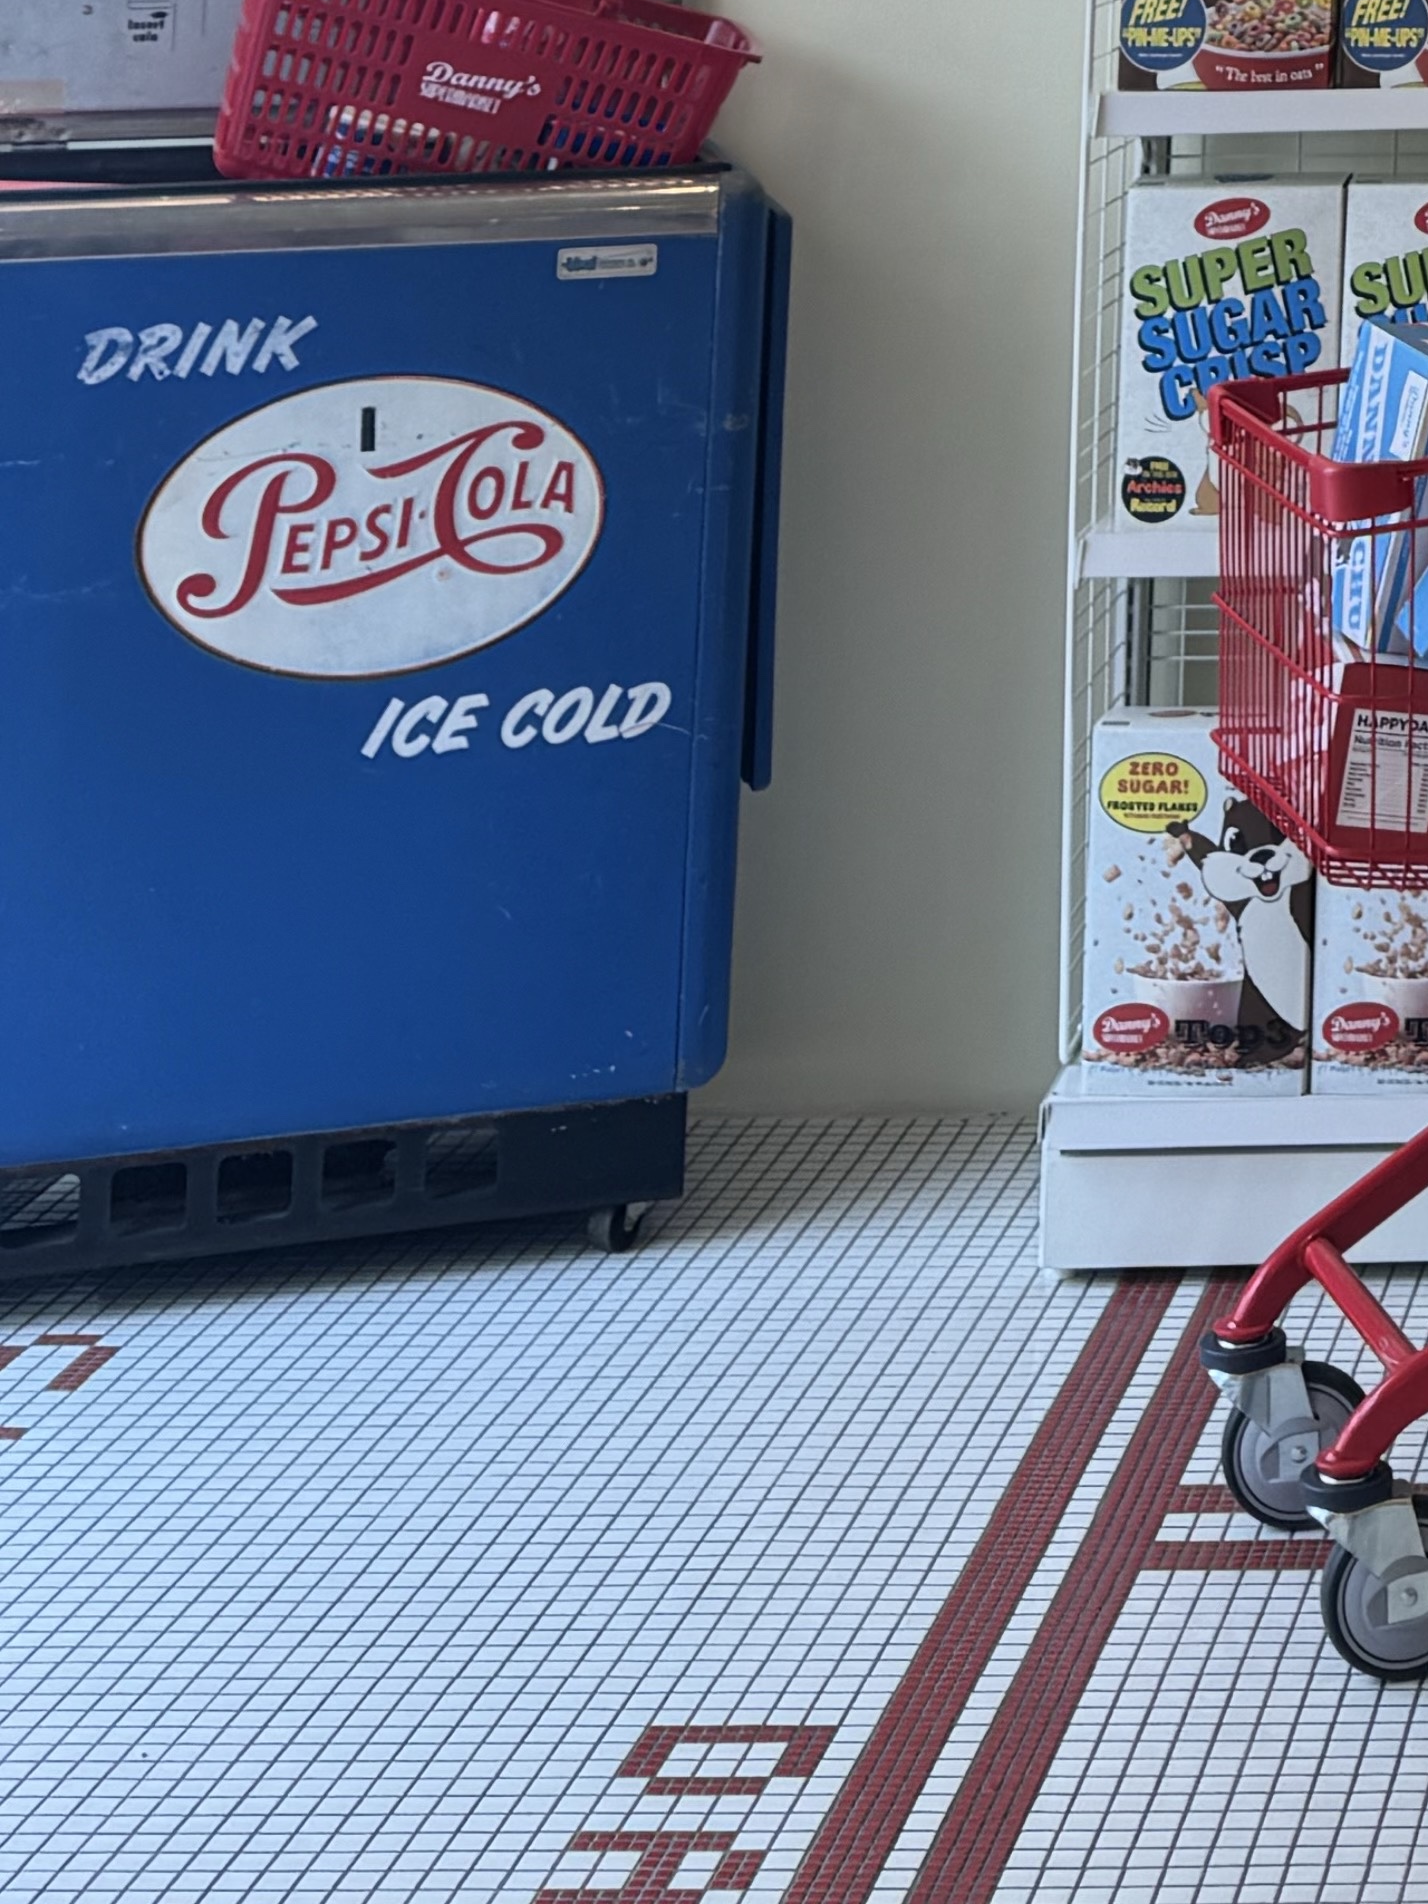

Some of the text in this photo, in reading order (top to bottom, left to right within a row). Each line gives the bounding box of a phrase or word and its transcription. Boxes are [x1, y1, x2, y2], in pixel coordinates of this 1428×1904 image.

[421, 61, 542, 100] Danny's
[1205, 202, 1260, 228] Danny's
[1130, 228, 1314, 321] SUPER
[76, 315, 318, 385] DRINK
[1138, 276, 1328, 373] SUGAR
[360, 681, 673, 759] ICE COLD
[1118, 778, 1189, 795] SUGAR!
[1128, 761, 1179, 778] ZERO
